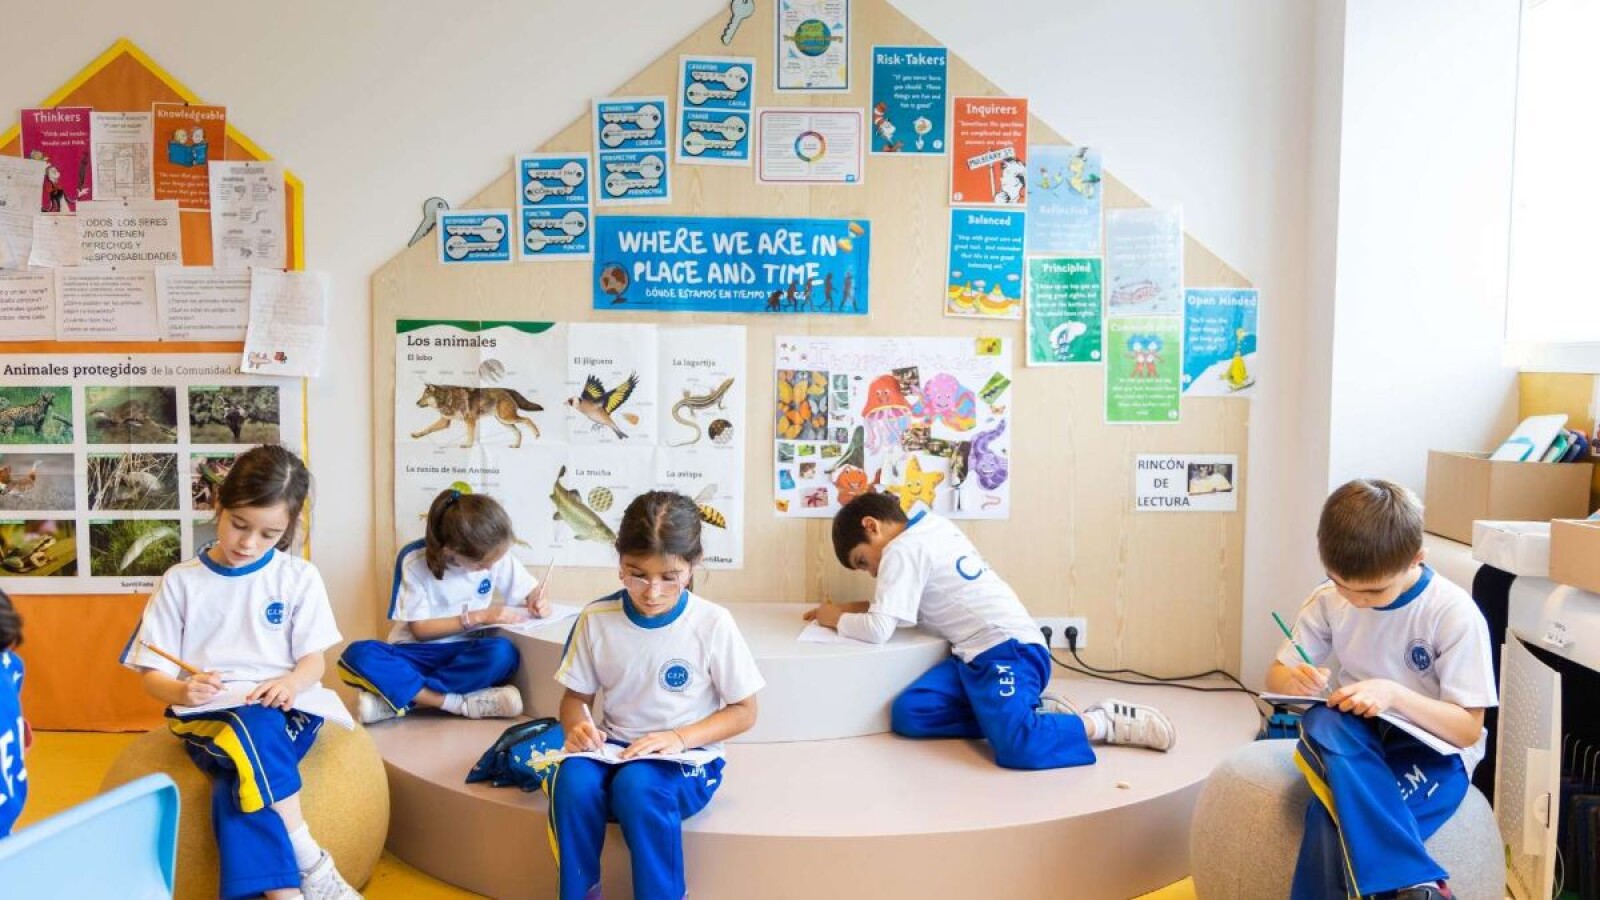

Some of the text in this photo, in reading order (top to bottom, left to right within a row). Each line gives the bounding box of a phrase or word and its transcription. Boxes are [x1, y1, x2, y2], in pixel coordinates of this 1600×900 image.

[876, 52, 945, 66] Risk-Takers
[158, 108, 225, 122] Knowledgeable
[966, 103, 1018, 117] Inquirers
[32, 110, 81, 123] Thinkers
[82, 218, 168, 227] ODOS LOS SERES
[967, 214, 1012, 226] Balanced
[111, 230, 145, 238] TIENEN
[135, 241, 141, 249] Y
[618, 227, 837, 256] WHERE WE ARE IN
[633, 260, 824, 286] PLACE AND TIME
[1042, 262, 1091, 275] Principled
[645, 286, 677, 297] DÓNDE
[678, 288, 717, 299] ESTAMOS
[718, 289, 731, 299] EN
[734, 289, 764, 299] TIEMPO
[1219, 295, 1257, 306] Minded
[407, 335, 497, 348] Los animales
[574, 357, 613, 367] El jilguero
[683, 359, 716, 368] lagartija
[3, 363, 69, 376] Animales
[73, 362, 147, 378] protegidos
[152, 366, 162, 376] de
[164, 365, 173, 376] la
[175, 365, 231, 376] Comunidad
[406, 465, 415, 473] La
[417, 465, 440, 473] ranita
[441, 465, 450, 473] de
[468, 466, 500, 474] Antonio
[1138, 458, 1185, 470] RINCÓN
[576, 468, 612, 476] La trucha
[666, 470, 703, 479] La avispa
[1154, 478, 1169, 488] DE
[1138, 496, 1190, 507] LECTURA
[704, 555, 733, 563] ntillana
